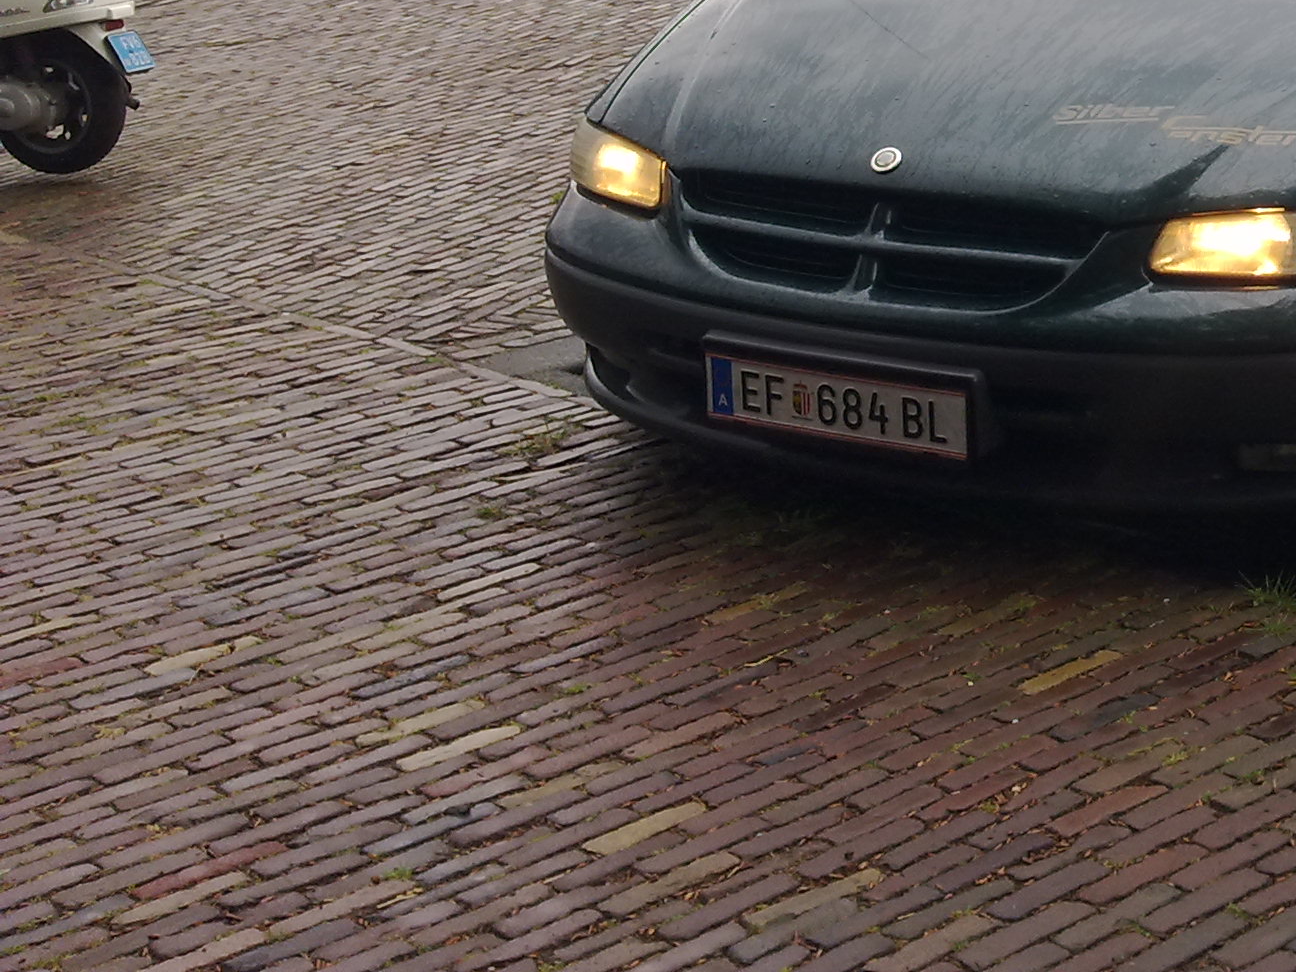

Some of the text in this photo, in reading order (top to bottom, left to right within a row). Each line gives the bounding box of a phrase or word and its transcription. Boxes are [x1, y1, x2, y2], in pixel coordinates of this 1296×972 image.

[718, 392, 728, 407] A
[740, 368, 948, 444] EF 684 BL
